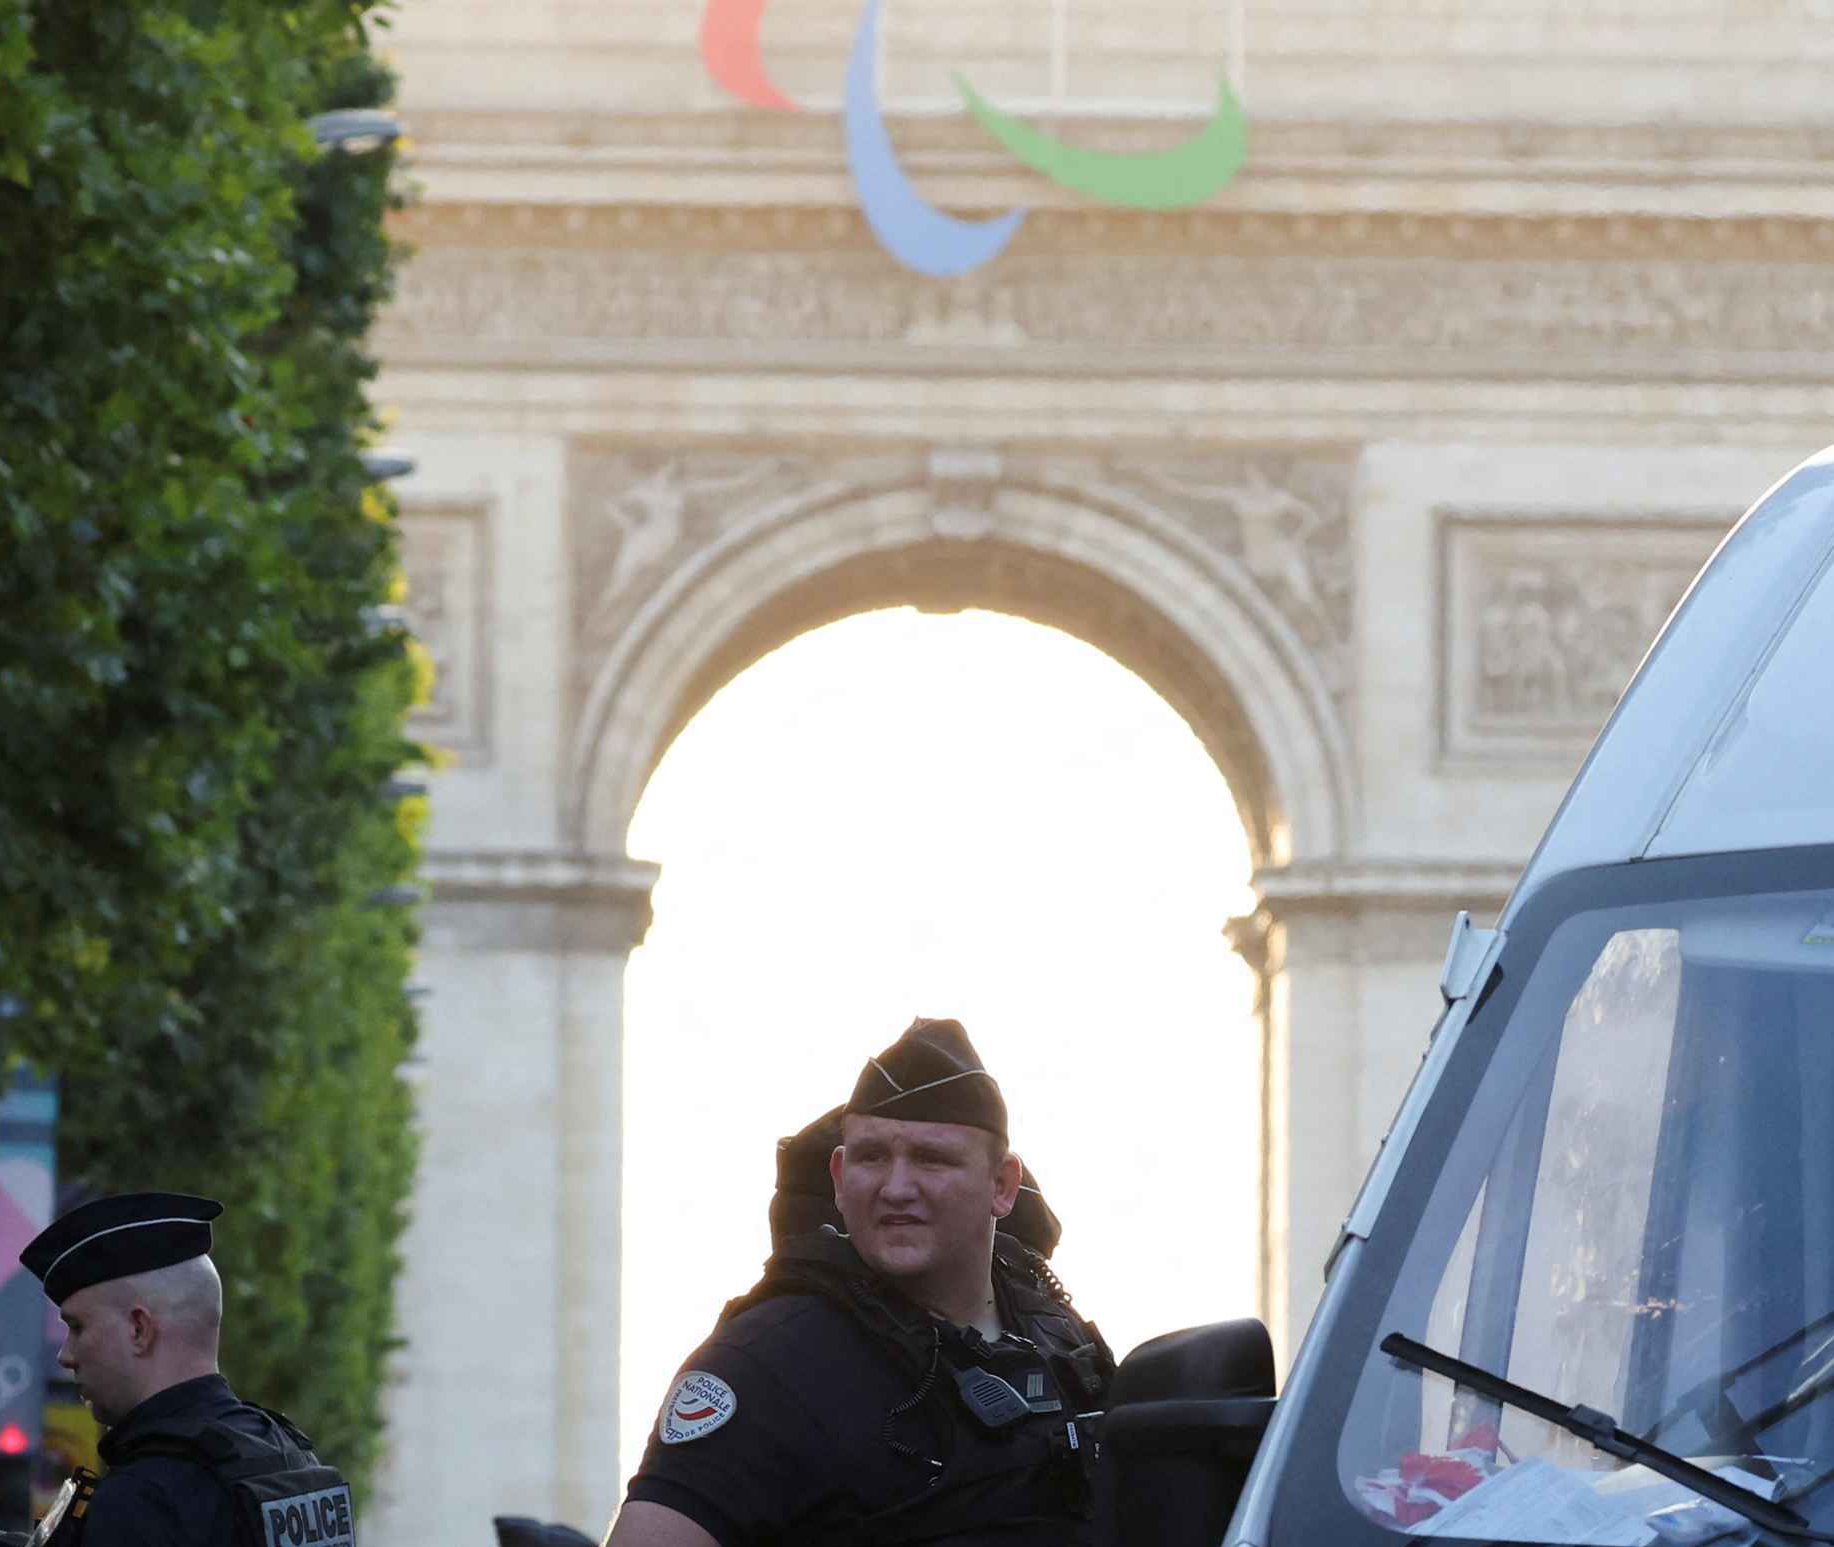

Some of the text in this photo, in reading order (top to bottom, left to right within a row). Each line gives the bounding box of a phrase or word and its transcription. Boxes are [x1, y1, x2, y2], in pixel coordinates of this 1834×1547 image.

[682, 1380, 731, 1413] NATIONALE
[697, 1377, 727, 1398] POLICE
[698, 1412, 725, 1431] POLICE
